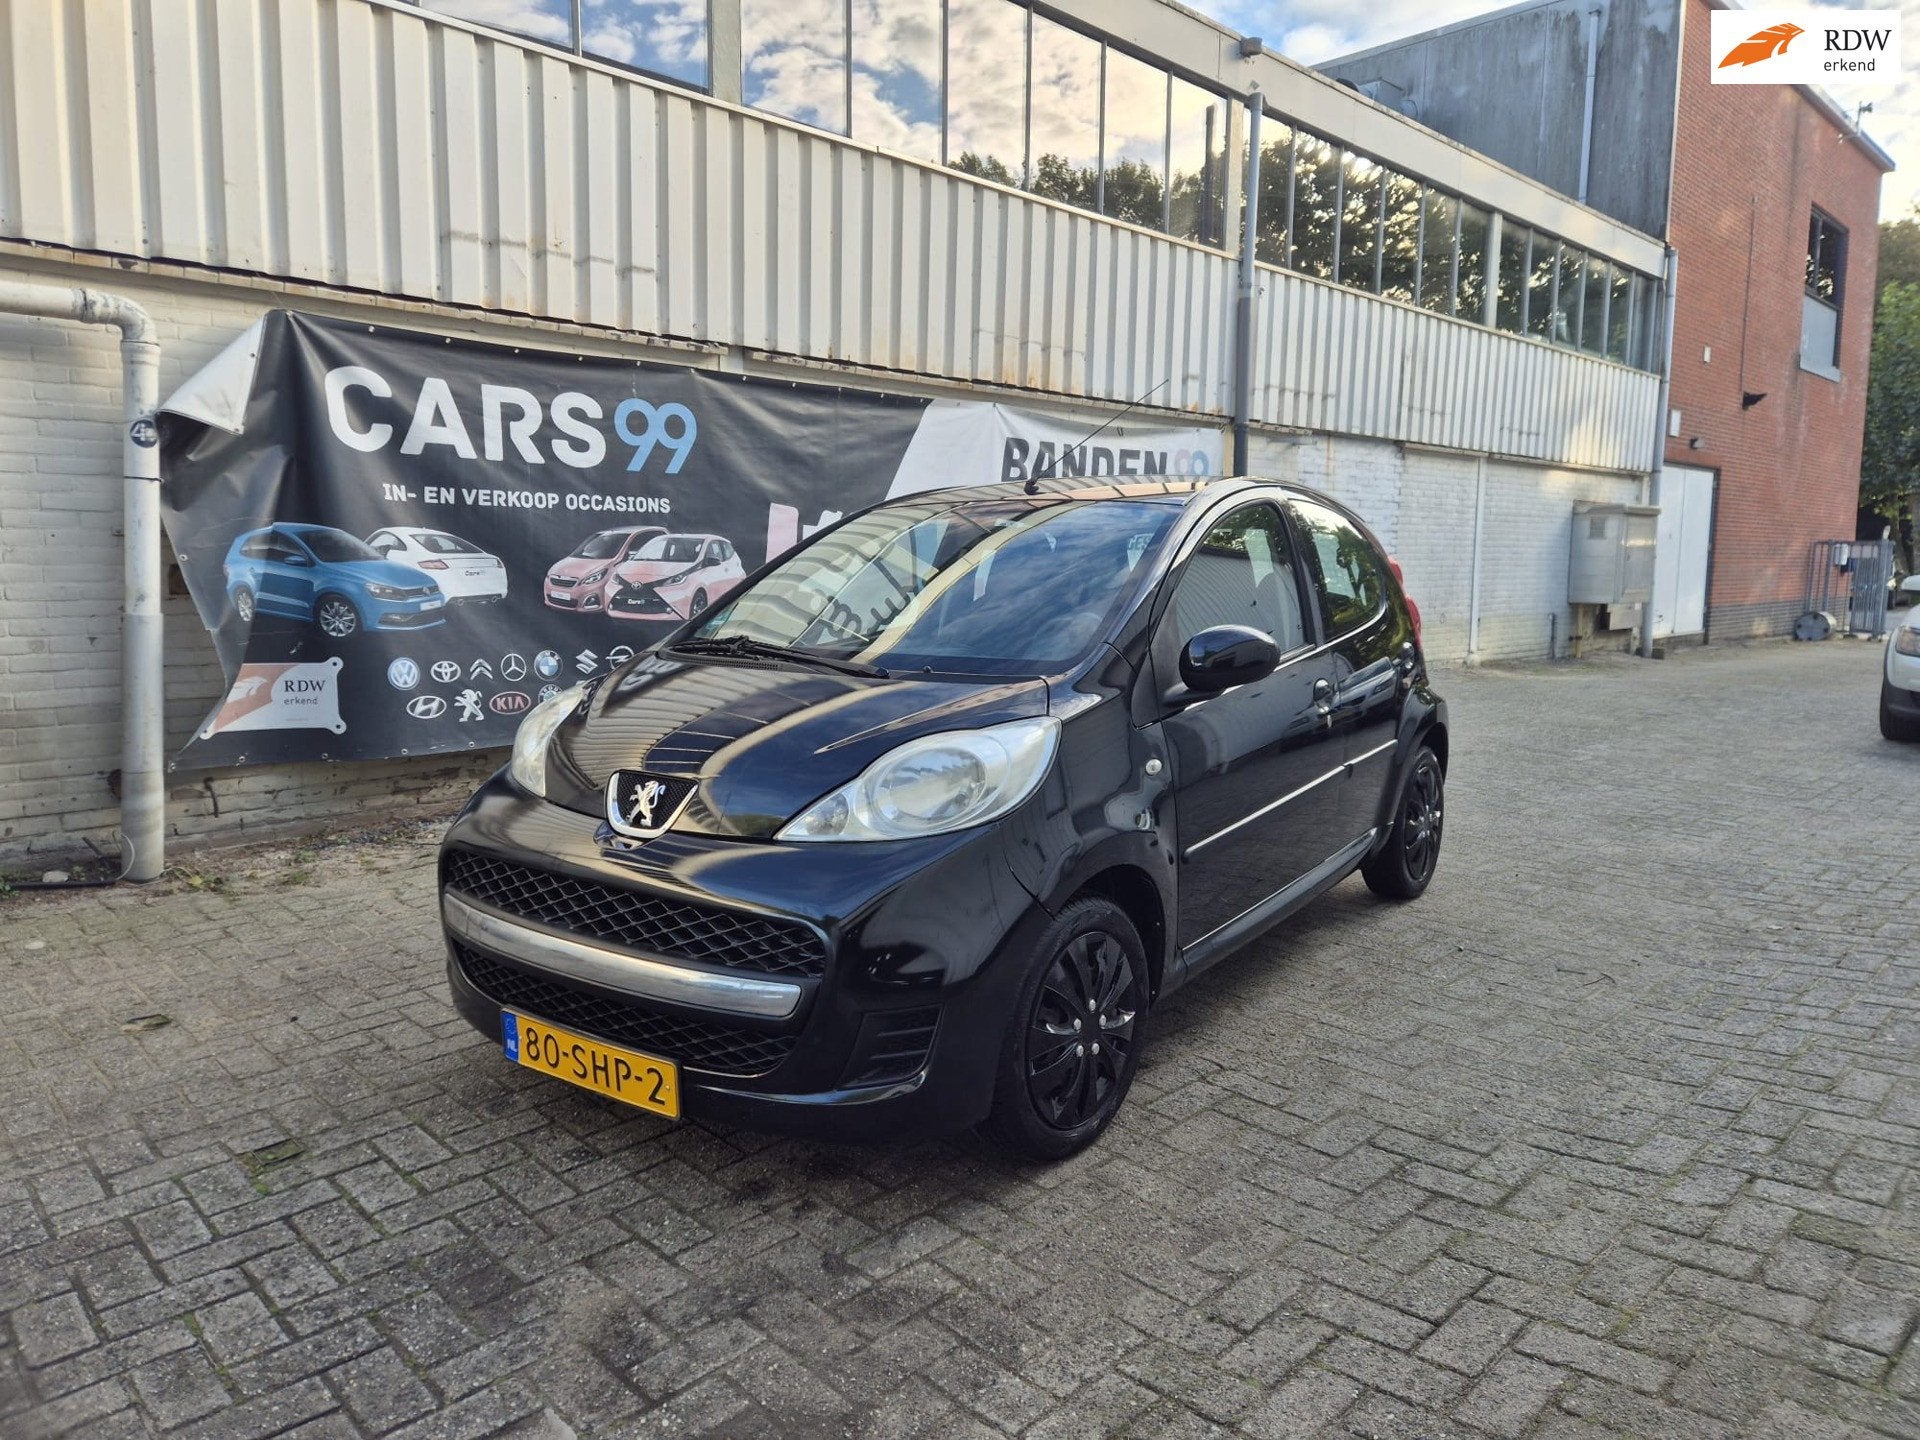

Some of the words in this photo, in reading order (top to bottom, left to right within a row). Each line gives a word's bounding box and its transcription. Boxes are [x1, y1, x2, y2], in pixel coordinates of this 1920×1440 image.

[382, 483, 417, 502] IN-
[424, 486, 455, 505] EN
[461, 488, 560, 509] VERKOOP
[565, 493, 671, 514] OCCASIONS
[283, 679, 327, 693] RDW
[283, 696, 319, 706] erkend
[496, 696, 526, 711] KIA
[525, 1027, 666, 1106] 80-SHP-2
